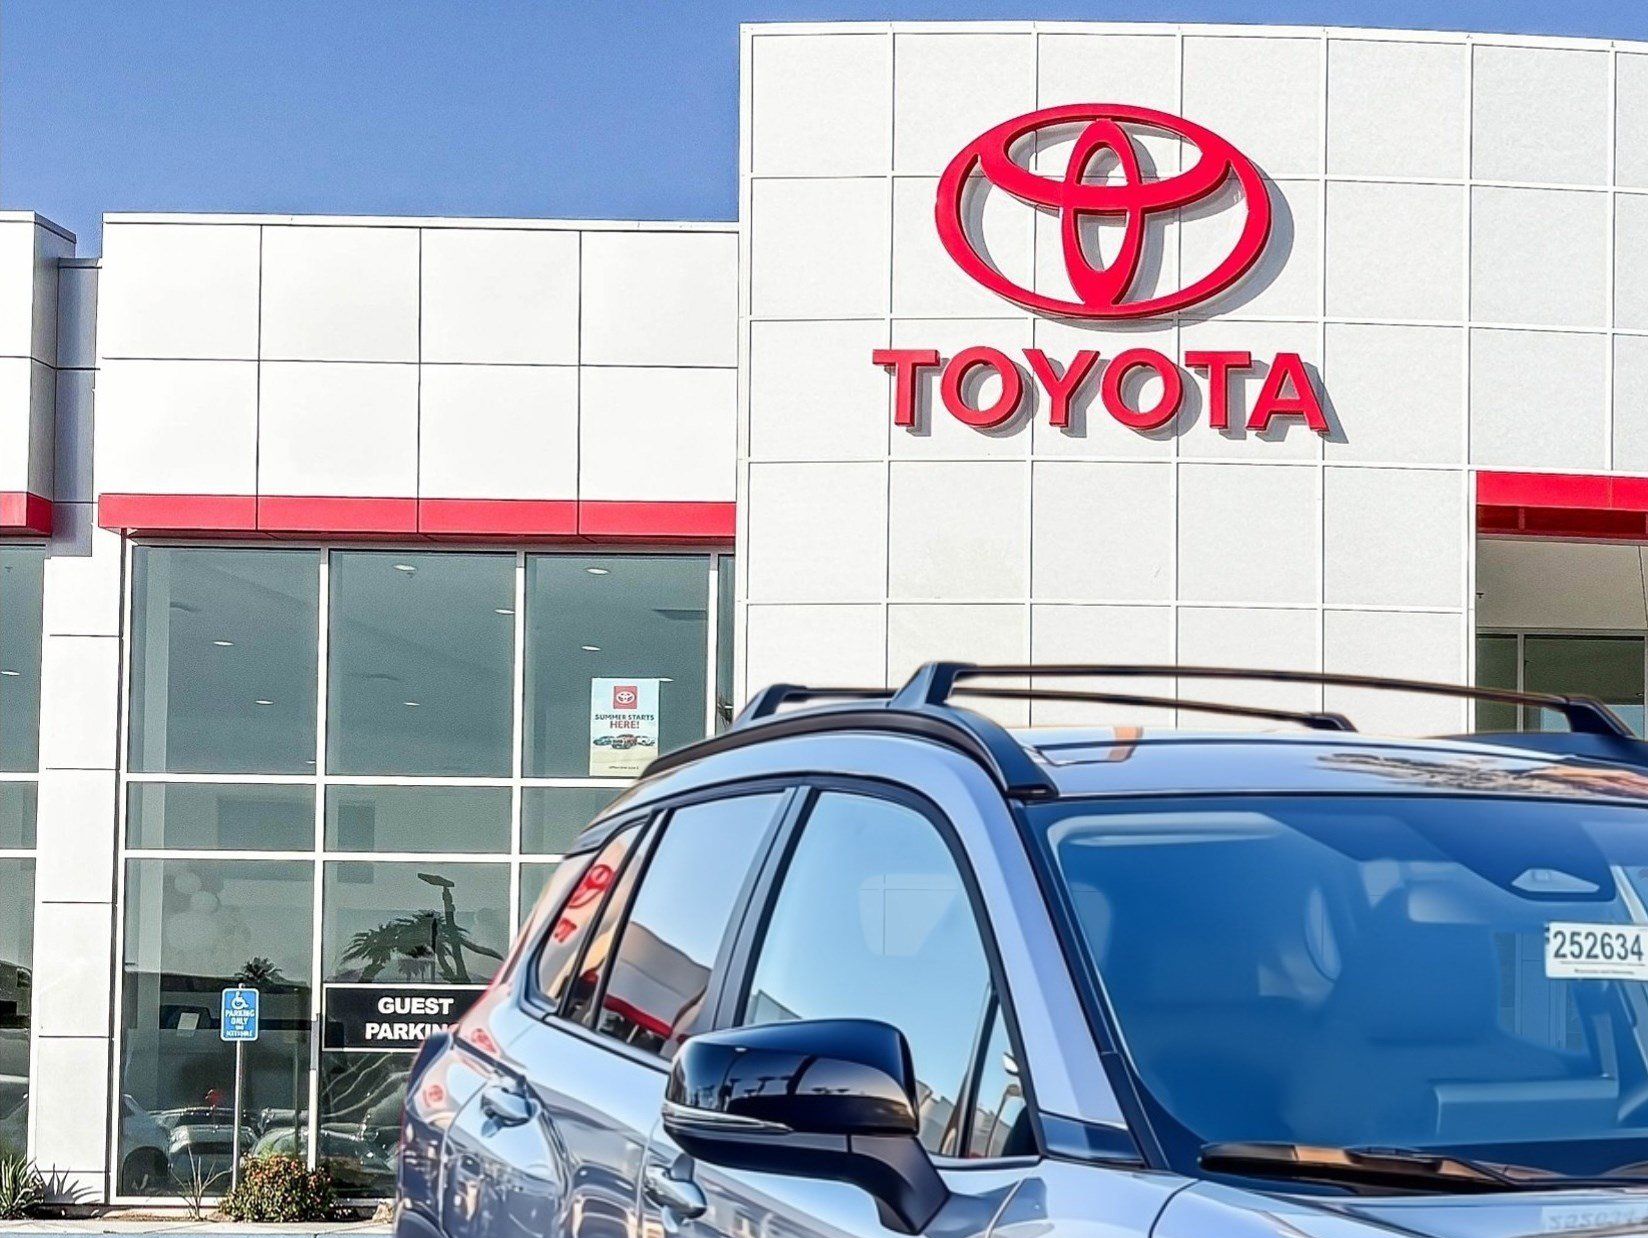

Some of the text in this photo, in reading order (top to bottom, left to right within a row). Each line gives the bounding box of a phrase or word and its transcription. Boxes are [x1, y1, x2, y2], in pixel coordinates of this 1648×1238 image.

[872, 346, 1329, 433] TOYOTA
[609, 721, 640, 729] HERE!
[1553, 930, 1644, 961] 252634
[377, 997, 454, 1015] GUEST
[365, 1023, 449, 1040] PARKIN
